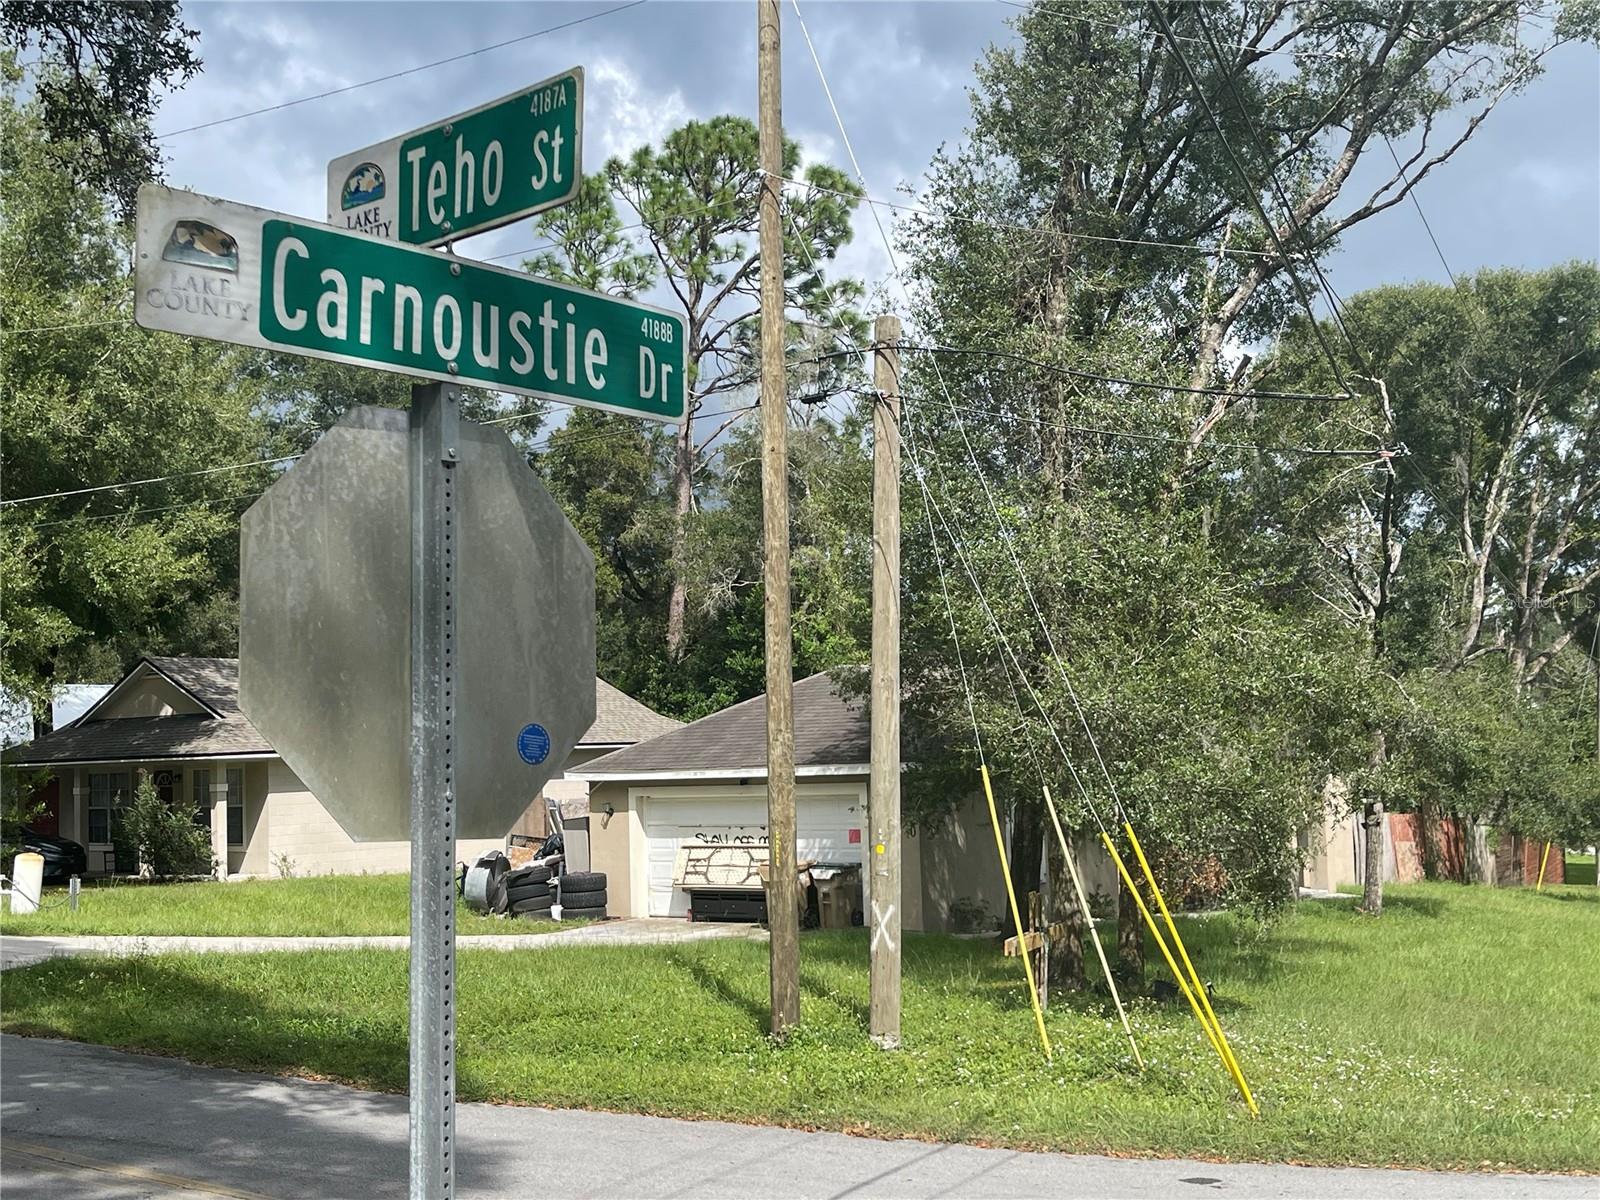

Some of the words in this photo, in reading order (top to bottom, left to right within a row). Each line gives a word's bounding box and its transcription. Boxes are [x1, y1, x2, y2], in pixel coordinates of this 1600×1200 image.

[530, 83, 567, 117] 4187A
[407, 133, 504, 232] Teho
[531, 125, 564, 191] St
[346, 206, 380, 230] LAKE
[170, 270, 232, 298] LAKE
[146, 287, 253, 322] COUNTY
[273, 236, 608, 390] Carnoustie
[639, 345, 673, 403] Dr
[641, 317, 673, 343] 4188B
